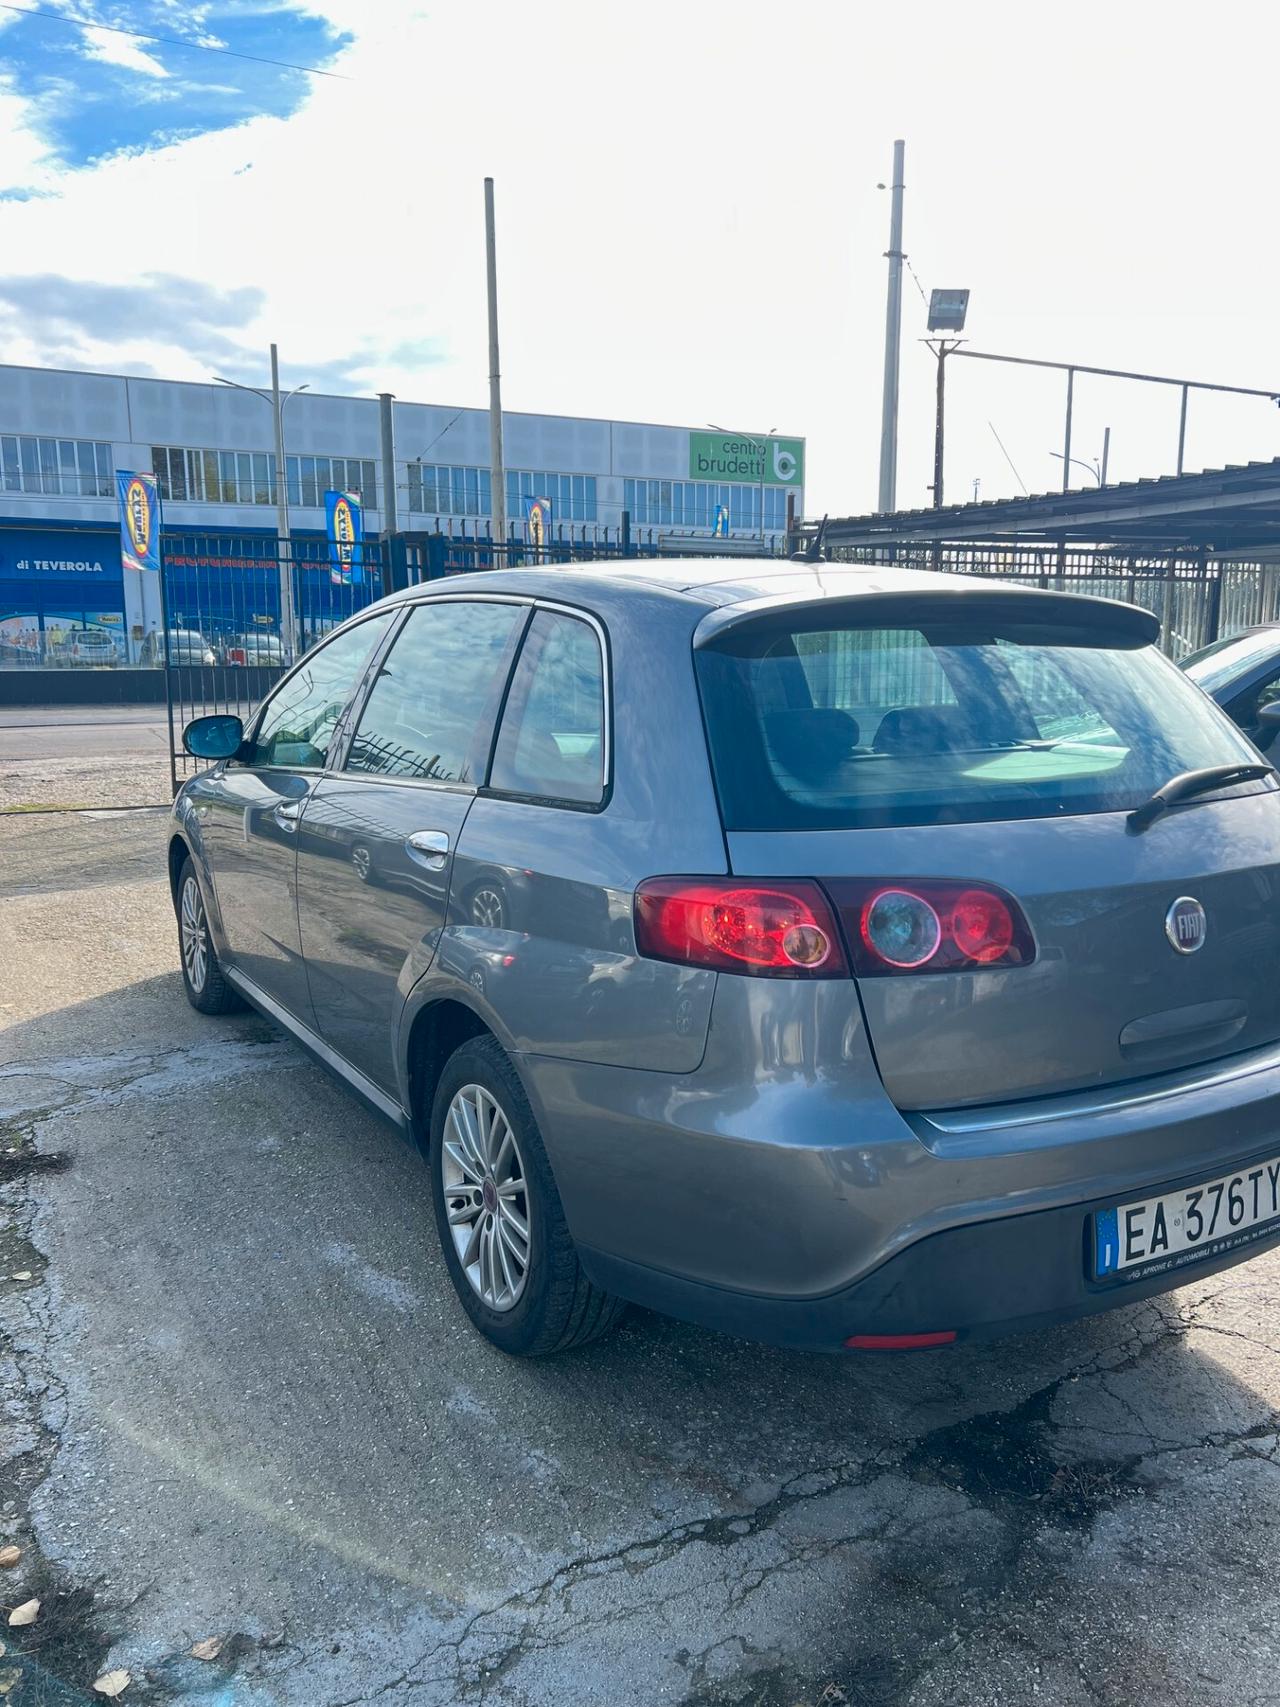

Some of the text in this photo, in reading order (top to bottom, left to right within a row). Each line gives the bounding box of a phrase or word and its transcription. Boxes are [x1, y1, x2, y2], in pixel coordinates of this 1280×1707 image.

[723, 442, 766, 456] centro
[698, 454, 765, 475] brudetti
[17, 560, 103, 571] di TEVEROLA
[1177, 913, 1200, 939] FIAT
[1125, 1162, 1280, 1261] EA 376TY
